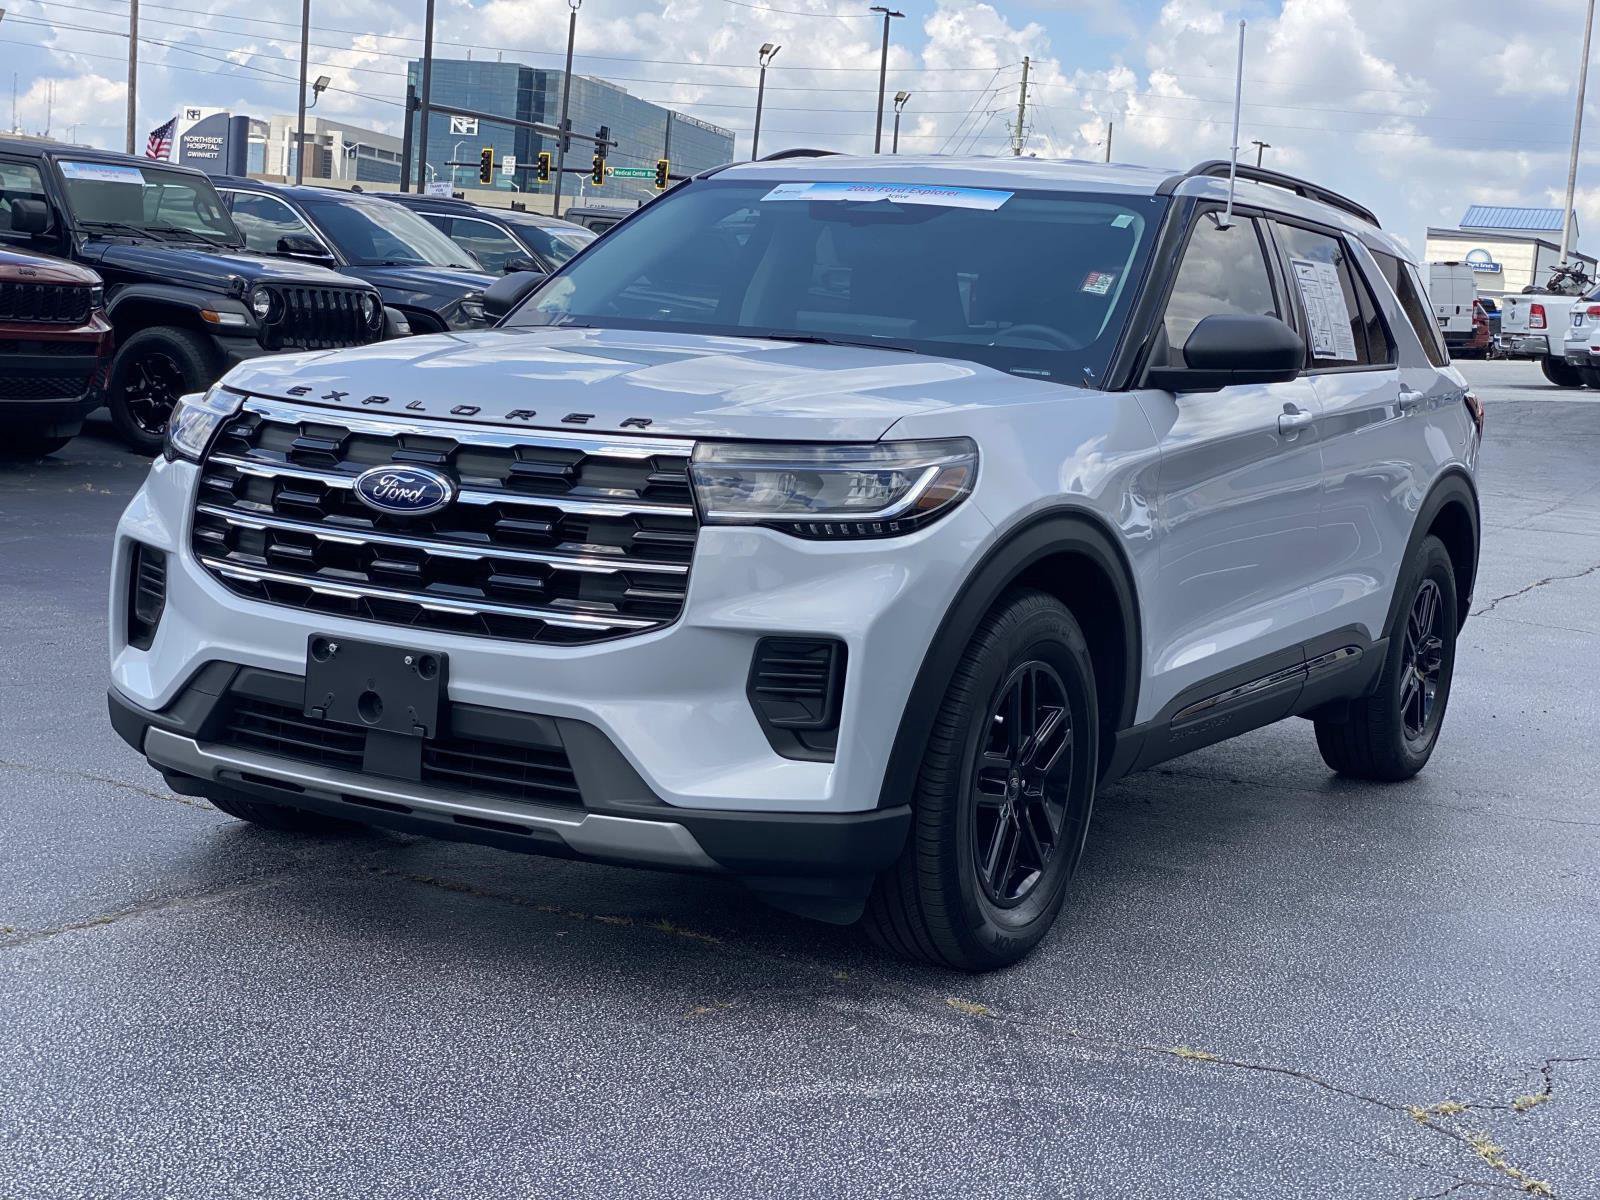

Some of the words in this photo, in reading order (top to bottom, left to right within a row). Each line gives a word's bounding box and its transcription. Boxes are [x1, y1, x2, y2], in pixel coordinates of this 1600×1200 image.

[183, 136, 224, 144] NORTHSIDE
[187, 143, 220, 151] HOSPITAL
[878, 186, 906, 194] Ford
[909, 187, 961, 197] Explorer
[286, 385, 653, 429] EXPLORER
[373, 474, 427, 503] Ford
